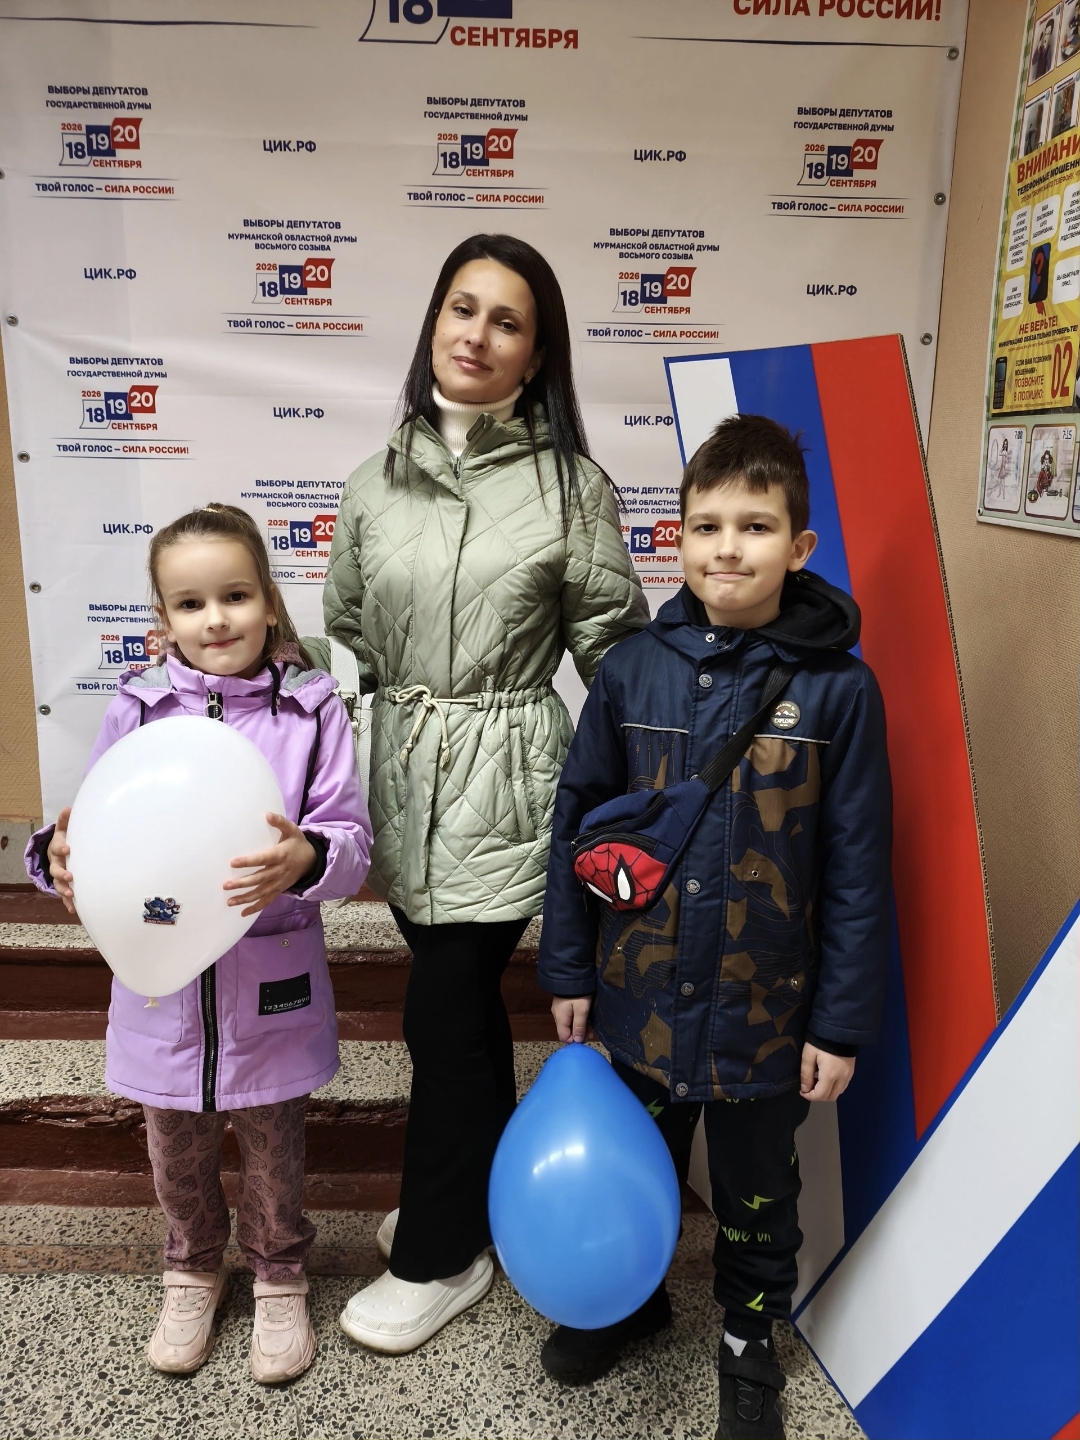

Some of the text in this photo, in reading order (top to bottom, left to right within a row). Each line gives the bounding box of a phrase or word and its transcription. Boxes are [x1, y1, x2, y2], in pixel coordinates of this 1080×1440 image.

[733, 0, 941, 21] СИЛА РОССИИ!
[450, 26, 579, 49] СЕНТЯБРЯ
[48, 85, 148, 96] ВЫБОРЫ ДЕПУТАТОВ
[46, 100, 125, 109] ГОСУДАРСТВЕННОЙ
[427, 97, 525, 107] ВЫБОРЫ ДЕПУТАТОВ
[424, 111, 502, 120] ГОСУДАРСТВЕННОЙ
[798, 107, 892, 118] ВЫБОРЫ ДЕПУТАТОВ
[794, 122, 894, 132] ГОСУДАРСТВЕННОЙ ДУМЫ
[66, 125, 137, 159] 18 19 20
[263, 139, 317, 154] ЦИК.РФ
[441, 135, 511, 168] 18 19 20
[633, 148, 687, 164] ЦИК.РФ
[93, 159, 142, 168] СЕНТЯБРЯ
[807, 146, 876, 179] 18 19 20
[466, 169, 514, 177] СЕНТЯБРЯ
[35, 182, 174, 194] ТВОЙ ГОЛОС СИЛА РОССИИ!
[830, 180, 877, 188] СЕНТЯБРЯ
[407, 191, 544, 203] ТВОЙ ГОЛОС СИЛА РОССИИ!
[772, 201, 904, 213] ТВОЙ ГОЛОС СИЛА РОССИИ!
[243, 219, 341, 229] ВЫБОРЫ ДЕПУТАТОВ
[285, 234, 331, 242] ОБЛАСТНОЙ
[610, 228, 704, 238] ВЫБОРЫ ДЕПУТАТОВ
[649, 243, 694, 251] ОБЛАСТНОЙ
[83, 267, 137, 281] ЦИК.РФ
[259, 265, 328, 297] 18 19 20
[621, 274, 689, 306] 18 19 20
[806, 283, 858, 298] ЦИК.РФ
[285, 298, 332, 306] СЕНТЯБРЯ
[645, 306, 690, 314] СЕНТЯБРЯ
[227, 319, 252, 328] ТВОЙ
[296, 322, 321, 330] СИЛА
[323, 323, 363, 331] РОССИИ!
[1019, 323, 1029, 335] НЕ
[587, 328, 611, 337] ТВОЙ
[613, 329, 643, 337] ГОЛОС
[69, 357, 163, 366] ВЫБОРЫ ДЕПУТАТОВ
[67, 370, 142, 378] ГОСУДАРСТВЕННОЙ
[1051, 341, 1073, 399] 02
[86, 392, 153, 422] 18 19 20
[273, 406, 324, 419] ЦИК.РФ
[624, 415, 674, 428] ЦИК.РФ
[57, 443, 80, 452] ТВОЙ
[103, 524, 153, 534] ЦИК.РФ
[271, 521, 335, 550] 18 19 20
[634, 527, 676, 548] 19 20
[105, 643, 144, 663] 18 19
